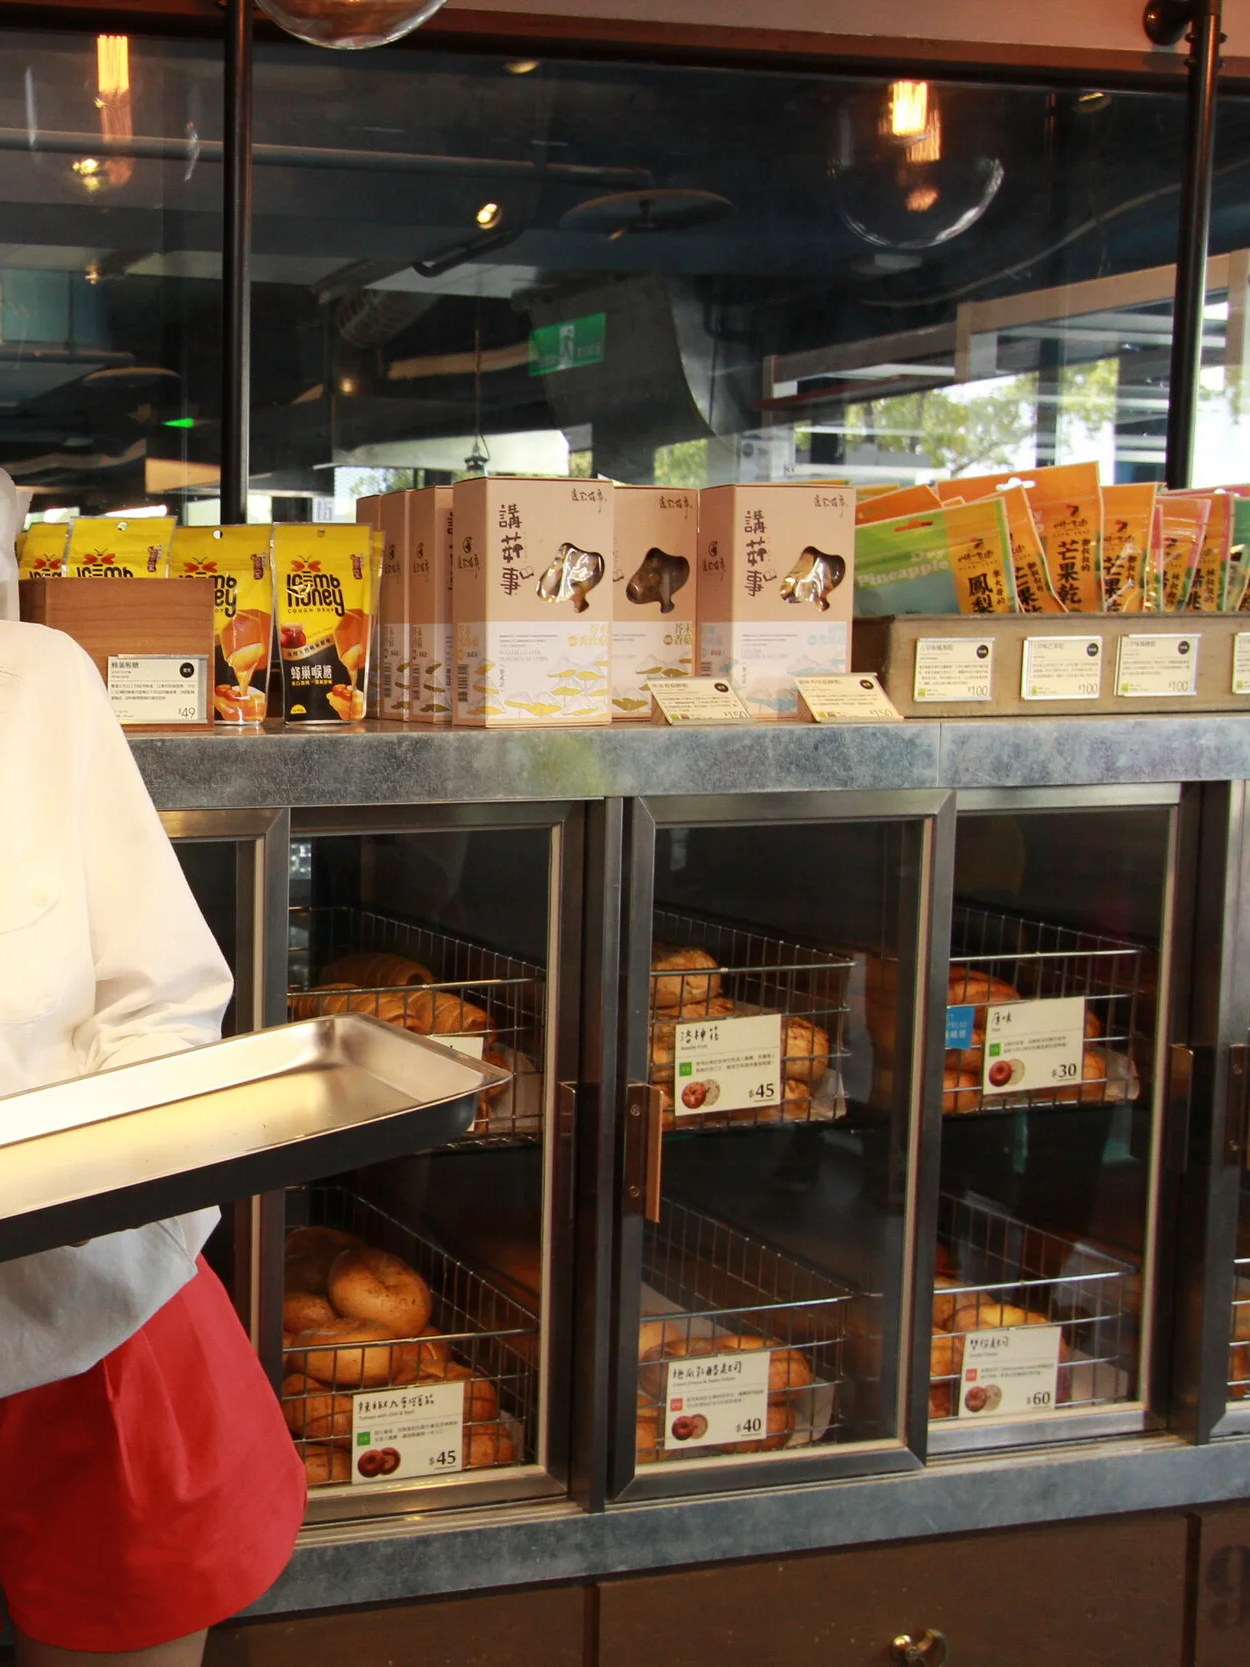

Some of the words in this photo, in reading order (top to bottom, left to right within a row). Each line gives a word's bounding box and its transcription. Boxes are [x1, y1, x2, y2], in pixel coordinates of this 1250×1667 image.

[1057, 539, 1082, 606] 芒果乾
[967, 572, 994, 613] 鳳梨
[287, 588, 346, 617] honey
[290, 665, 332, 680] 蜂巢喉糖
[178, 707, 196, 718] $49
[680, 1025, 719, 1043] 洛神花
[1052, 1063, 1077, 1078] $30
[748, 1083, 775, 1098] $45
[1026, 1391, 1051, 1405] $60
[736, 1418, 761, 1433] $40
[429, 1450, 456, 1466] $45
